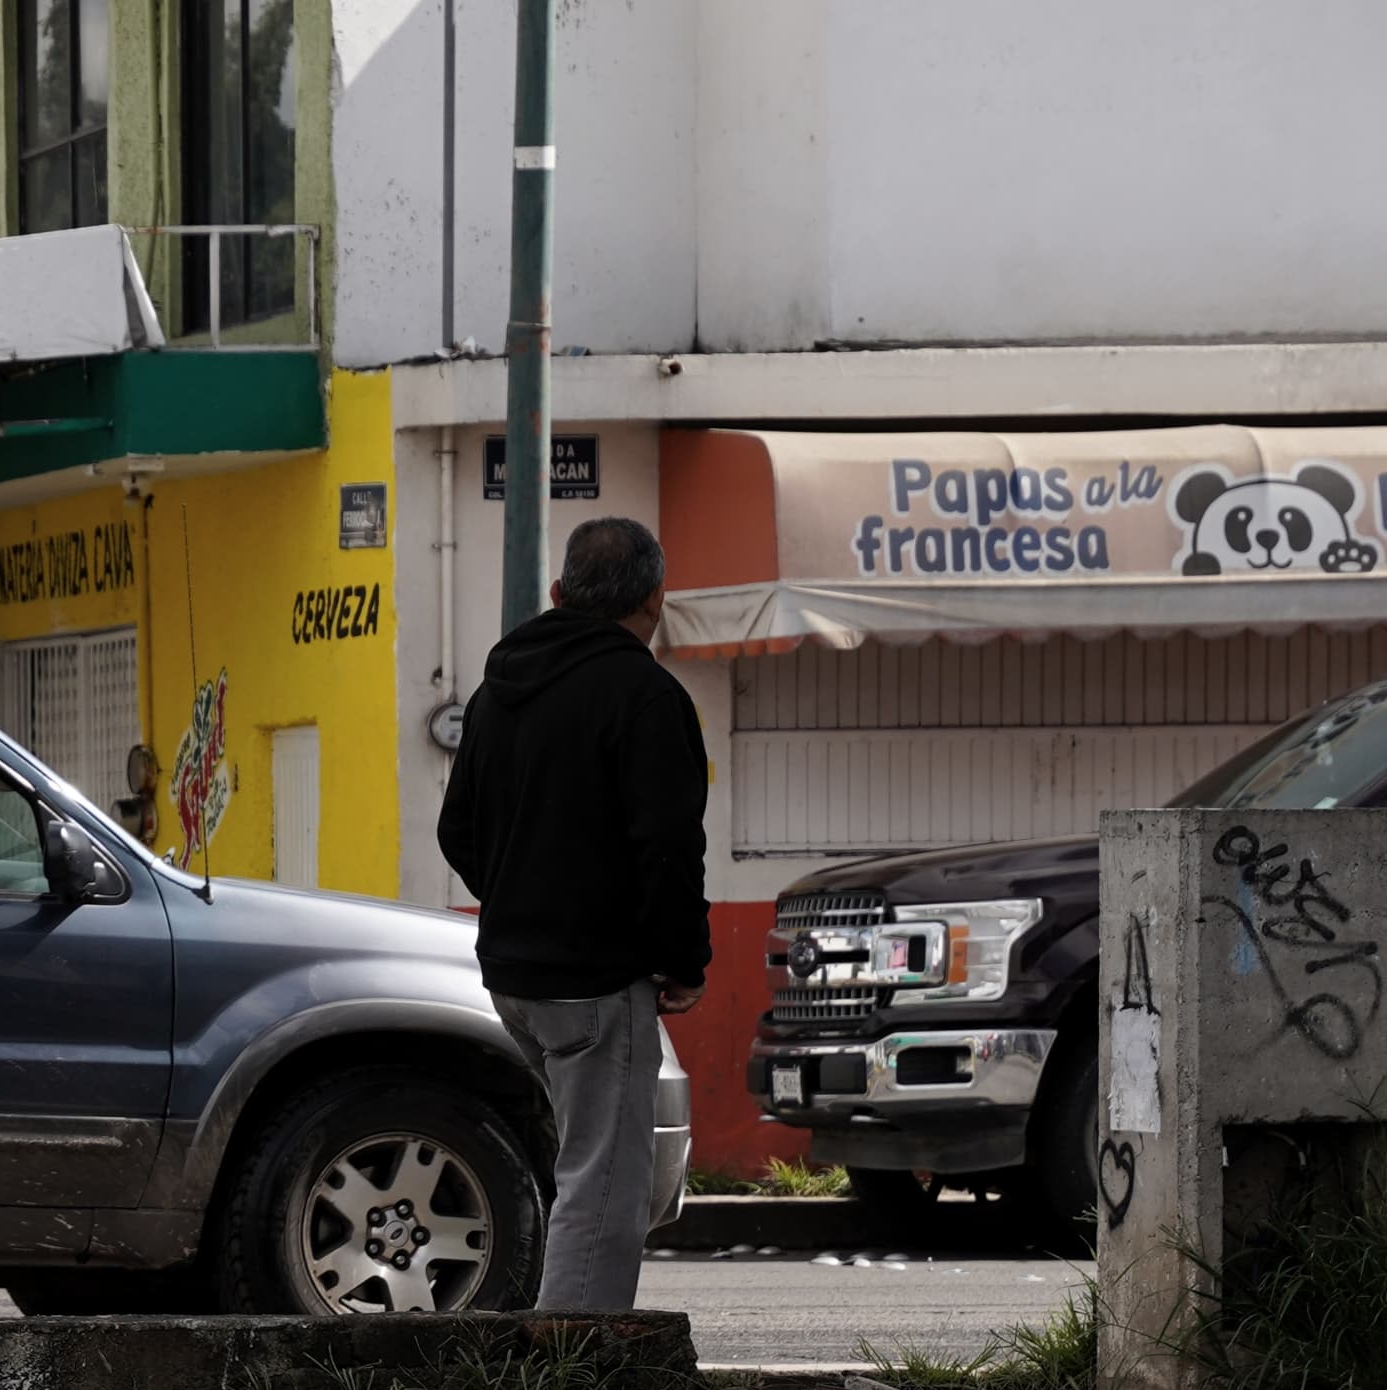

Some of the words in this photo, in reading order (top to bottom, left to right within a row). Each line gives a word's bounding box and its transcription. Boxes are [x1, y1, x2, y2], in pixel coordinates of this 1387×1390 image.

[494, 462, 589, 480] MACAN
[891, 458, 1074, 526] Papas
[1086, 474, 1116, 507] a
[1119, 459, 1163, 503] la
[855, 515, 1110, 573] francesa
[292, 582, 380, 645] CERVEZA
